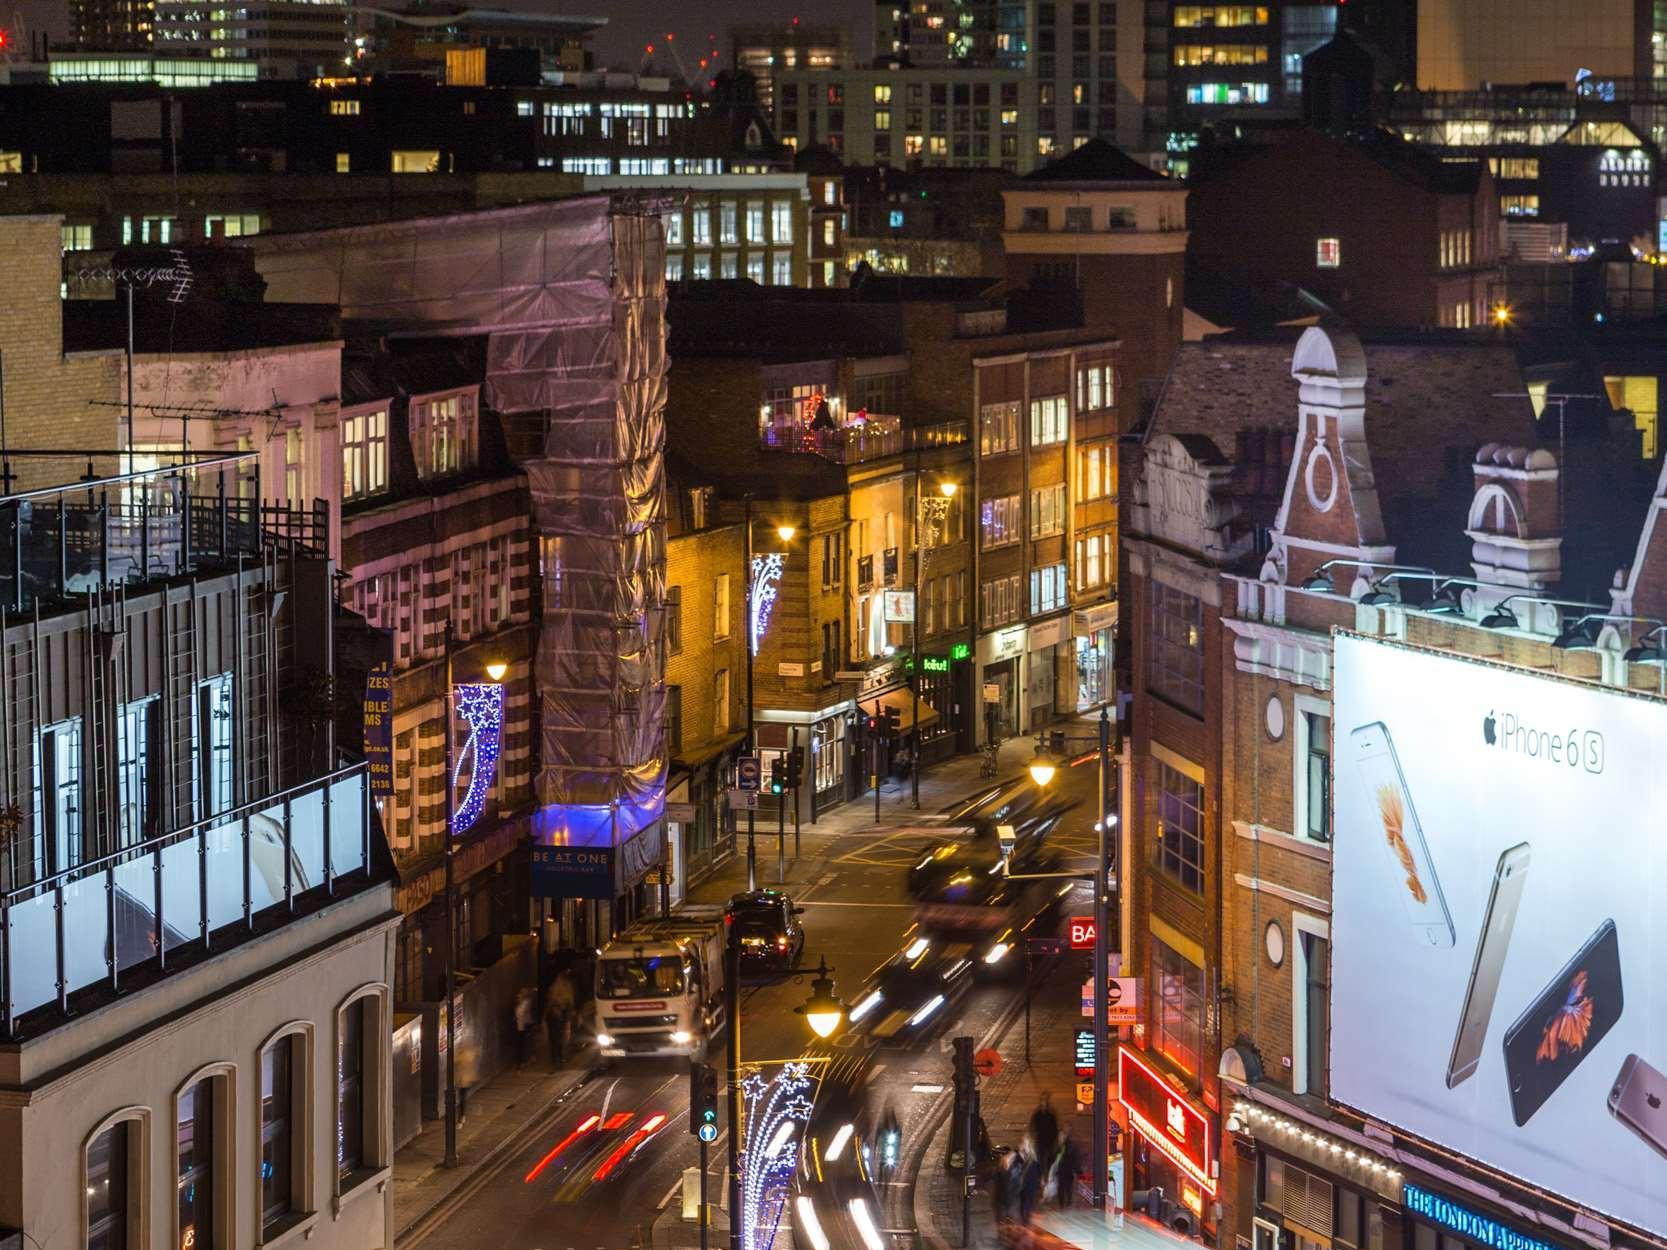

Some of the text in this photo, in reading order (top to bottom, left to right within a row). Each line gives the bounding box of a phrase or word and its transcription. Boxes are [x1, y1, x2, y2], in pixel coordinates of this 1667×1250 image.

[1500, 713, 1562, 763] iPhone
[533, 852, 608, 864] BE AT ONE
[1072, 925, 1096, 942] BA
[1403, 1183, 1433, 1218] THE
[1434, 1197, 1497, 1245] LONDON
